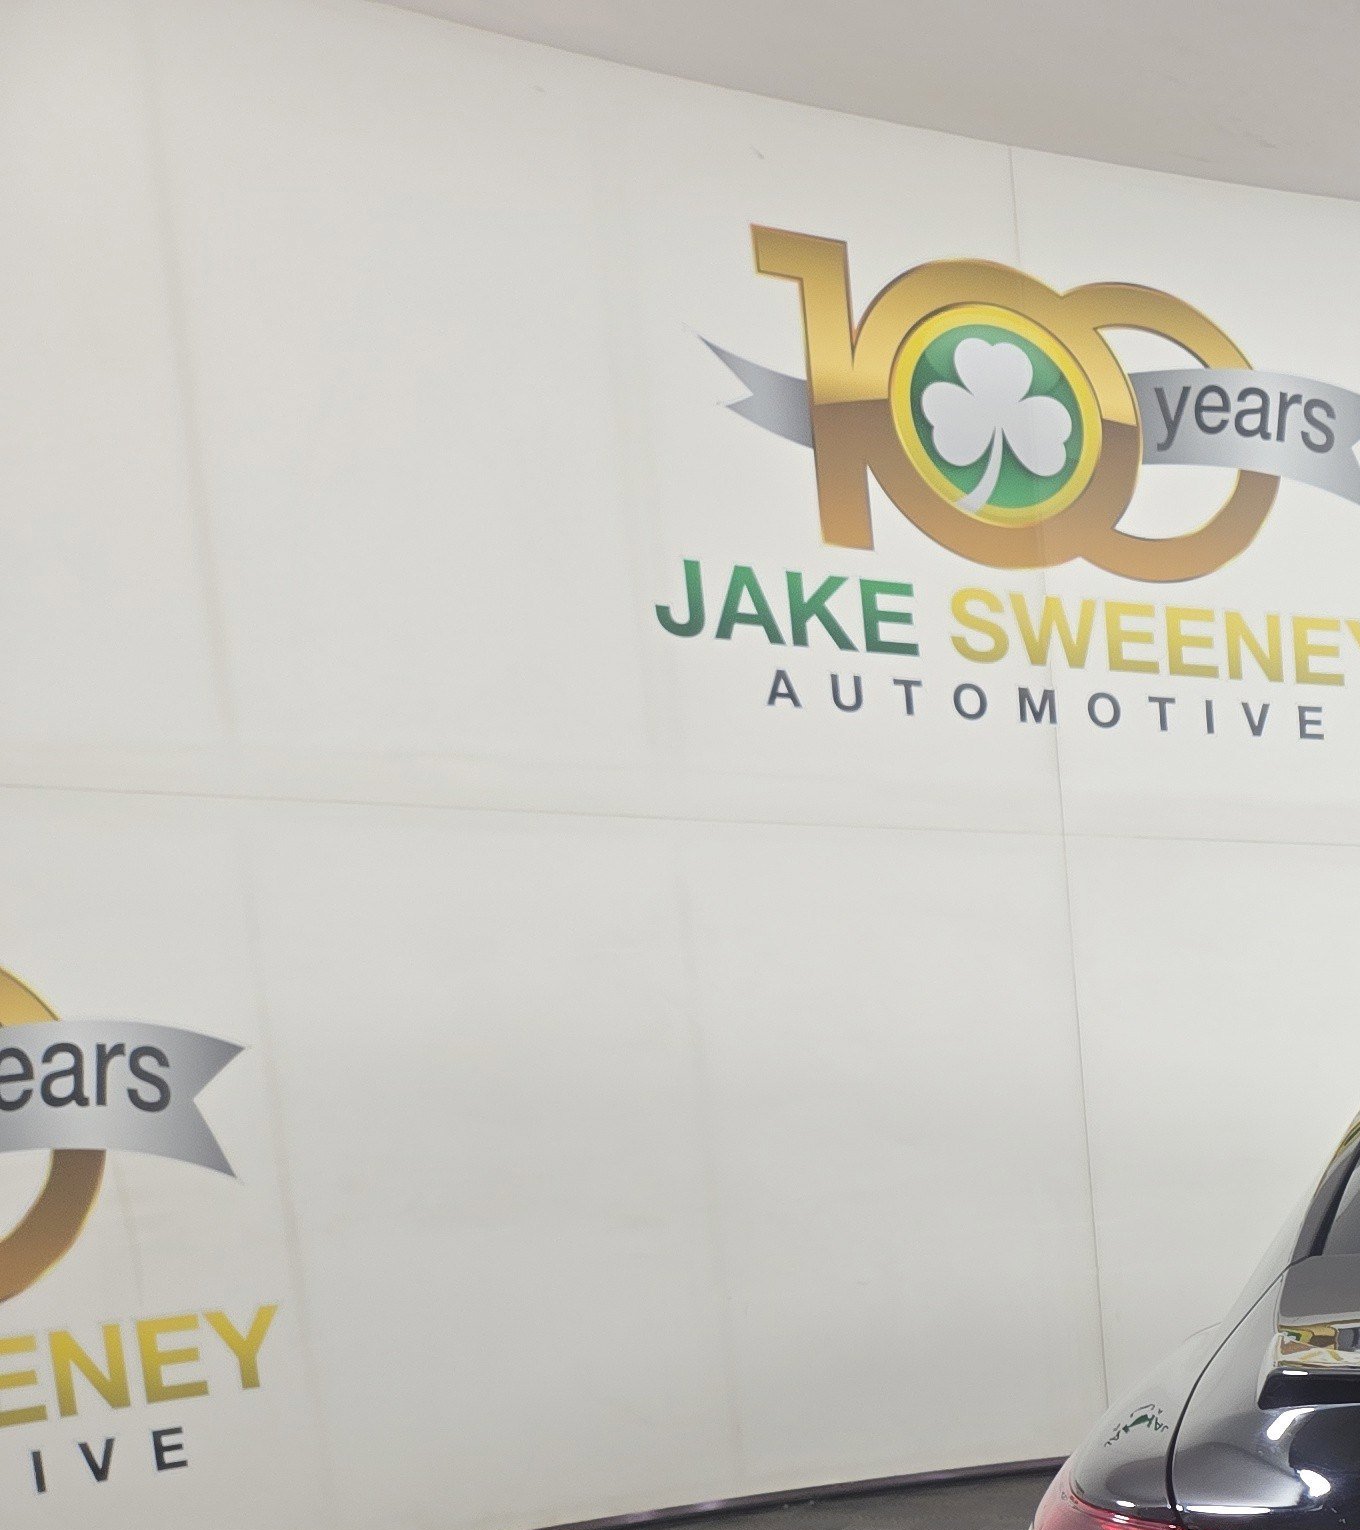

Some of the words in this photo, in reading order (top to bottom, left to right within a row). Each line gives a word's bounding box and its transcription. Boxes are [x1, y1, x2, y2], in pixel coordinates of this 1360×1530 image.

[750, 223, 1281, 585] 100
[1154, 383, 1338, 454] years
[655, 559, 920, 658] JAKE
[766, 668, 1326, 741] AUTOMOTIVE
